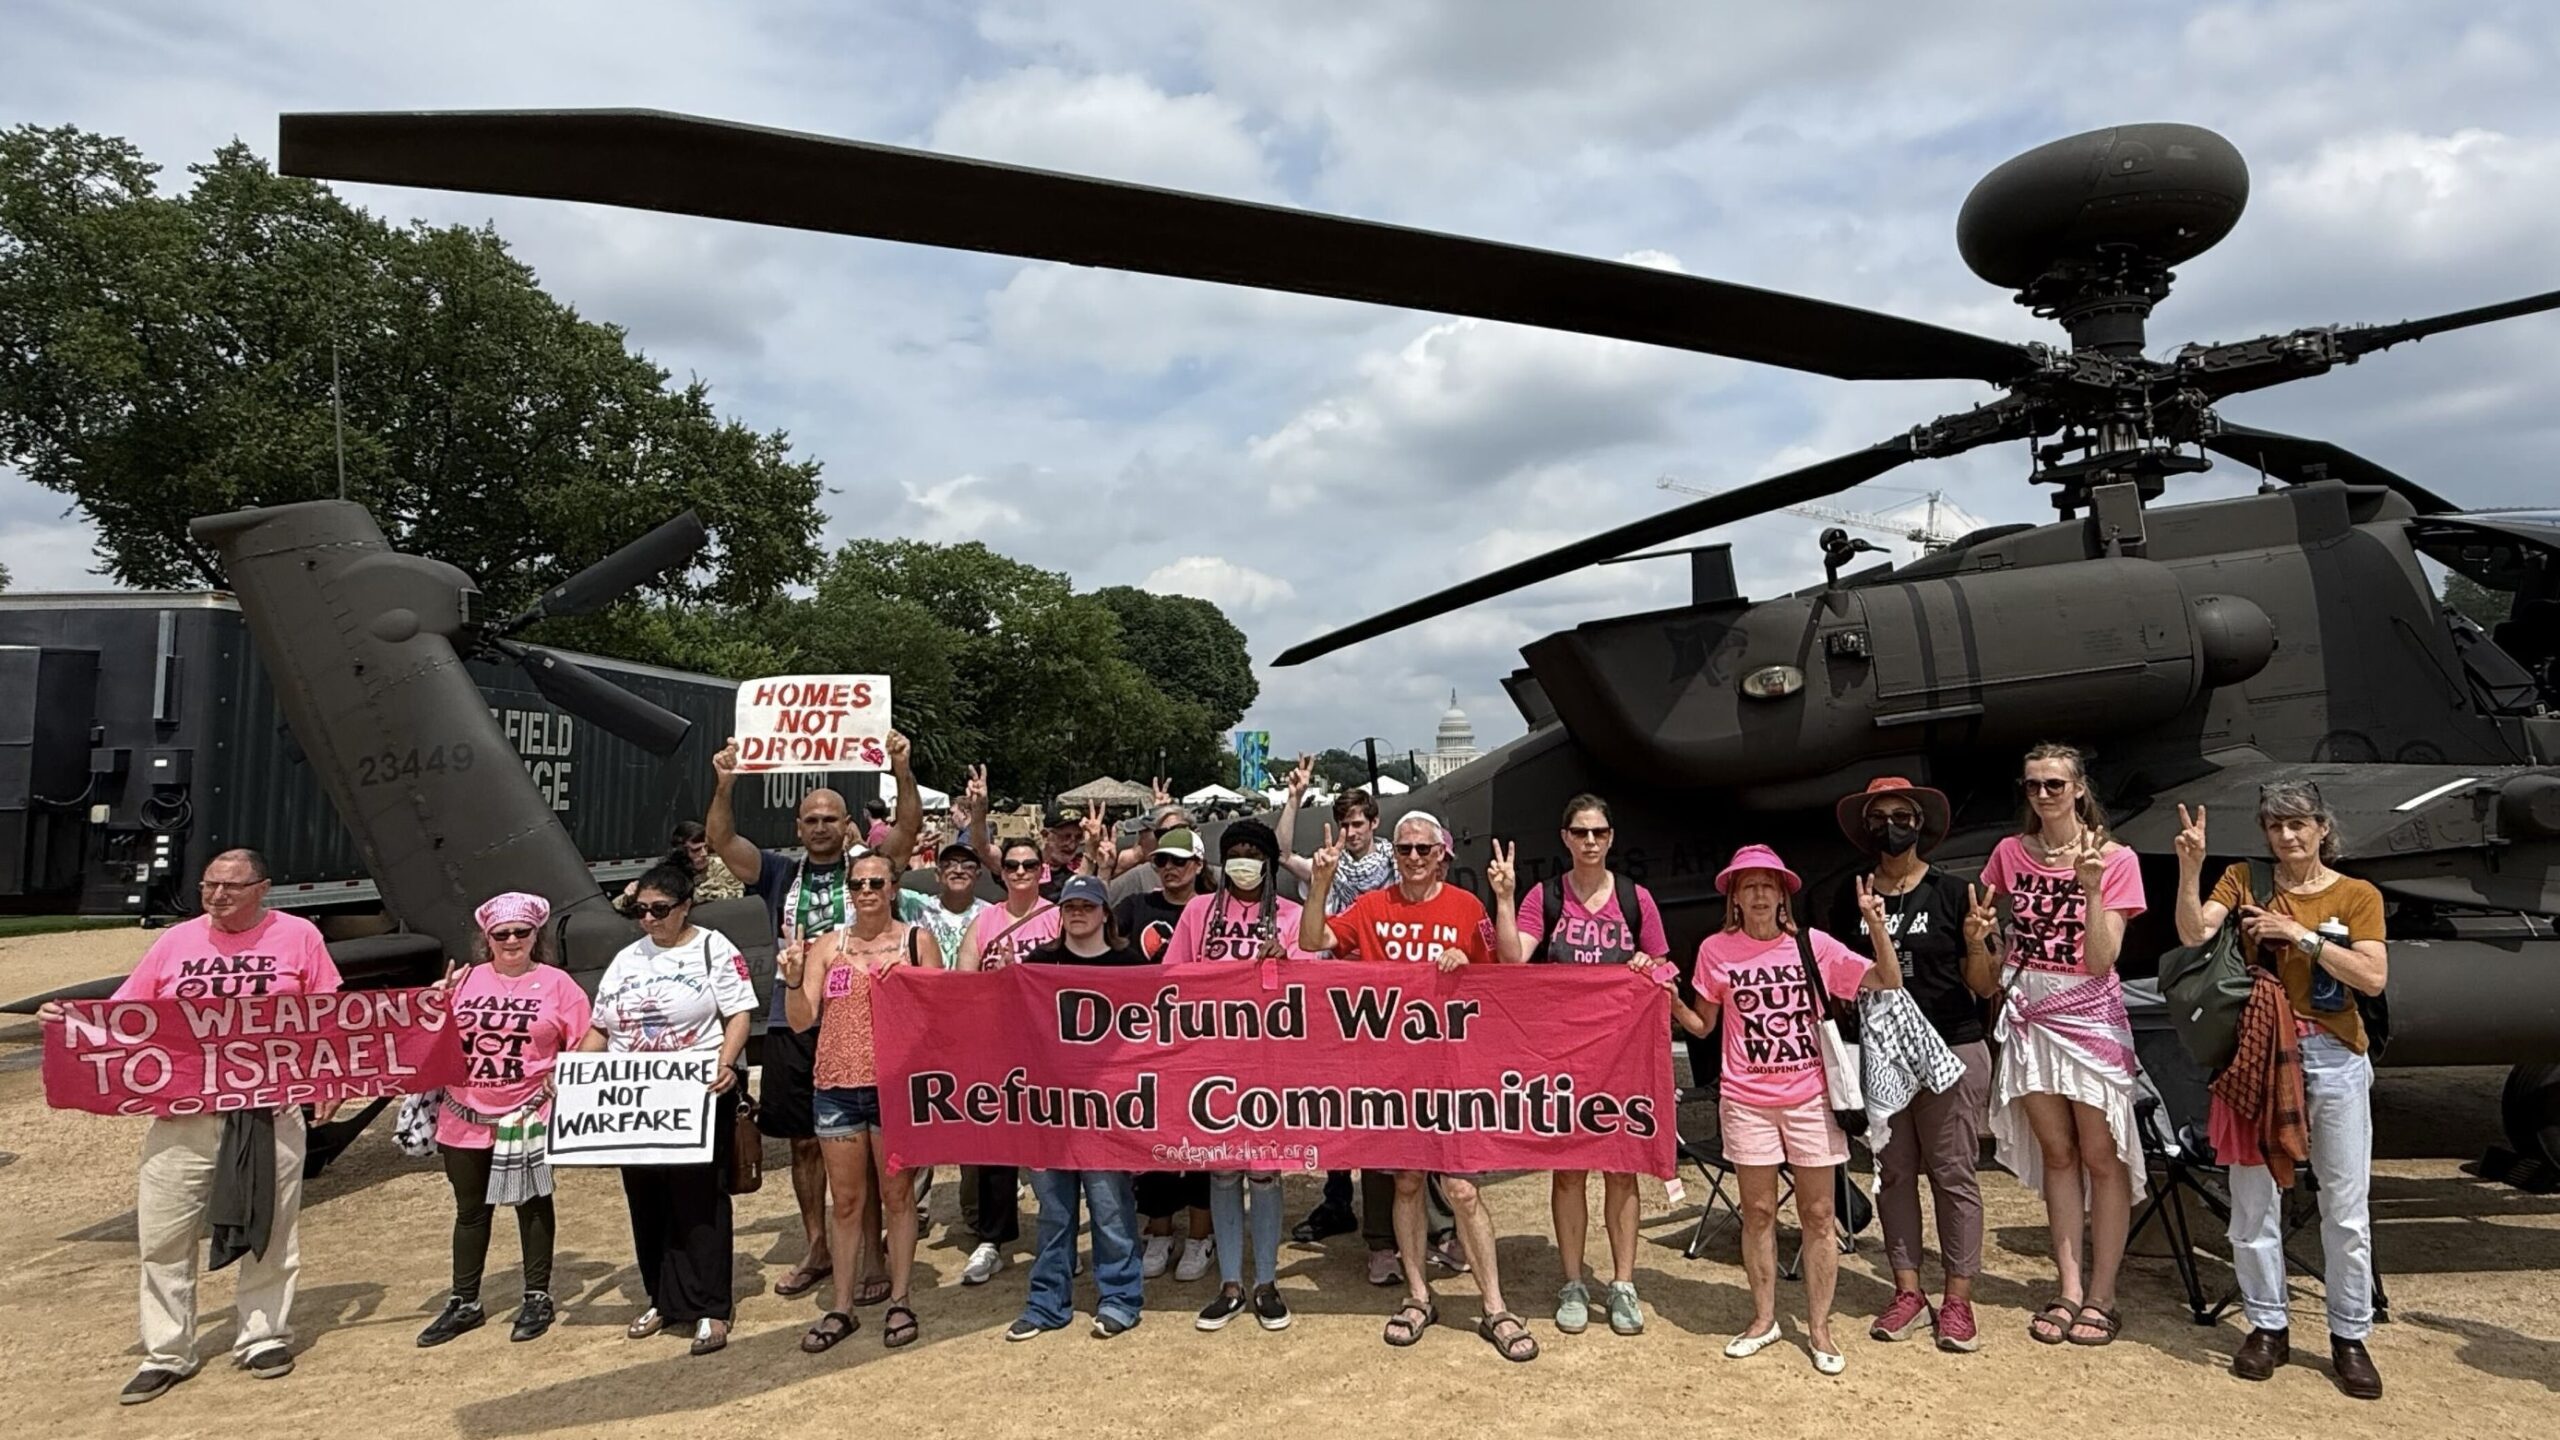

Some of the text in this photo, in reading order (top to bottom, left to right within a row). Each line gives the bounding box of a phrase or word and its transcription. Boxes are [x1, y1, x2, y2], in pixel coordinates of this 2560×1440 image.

[753, 683, 872, 708] HOMES
[505, 709, 573, 756] FIELD
[774, 710, 850, 735] NOT
[358, 743, 475, 787] 23449
[2013, 893, 2085, 918] OUT
[1375, 921, 1424, 940] NOT
[1433, 924, 1458, 943] IN
[1552, 917, 1635, 951] PEACE
[1385, 940, 1444, 962] OUR
[1574, 947, 1603, 964] not
[179, 955, 277, 978] MAKE
[176, 974, 277, 999] OUT
[1733, 984, 1809, 1014] OUT
[458, 996, 542, 1012] MAKE
[1056, 983, 1480, 1045] Defund War
[63, 989, 448, 1049] NO WEAPONS
[455, 1011, 538, 1032] OUT
[1740, 1010, 1812, 1038] NOT
[462, 1032, 532, 1057] NOT
[1744, 1035, 1820, 1064] WAR
[79, 1033, 417, 1095] TO ISRAEL
[558, 1058, 716, 1085] HEALTHCARE
[1746, 1060, 1823, 1075] CODEPINK.ORG
[117, 1081, 406, 1115] CODEPINK
[598, 1085, 652, 1108] NOT
[908, 1066, 1658, 1138] Refund Communities
[557, 1108, 693, 1139] WARFARE
